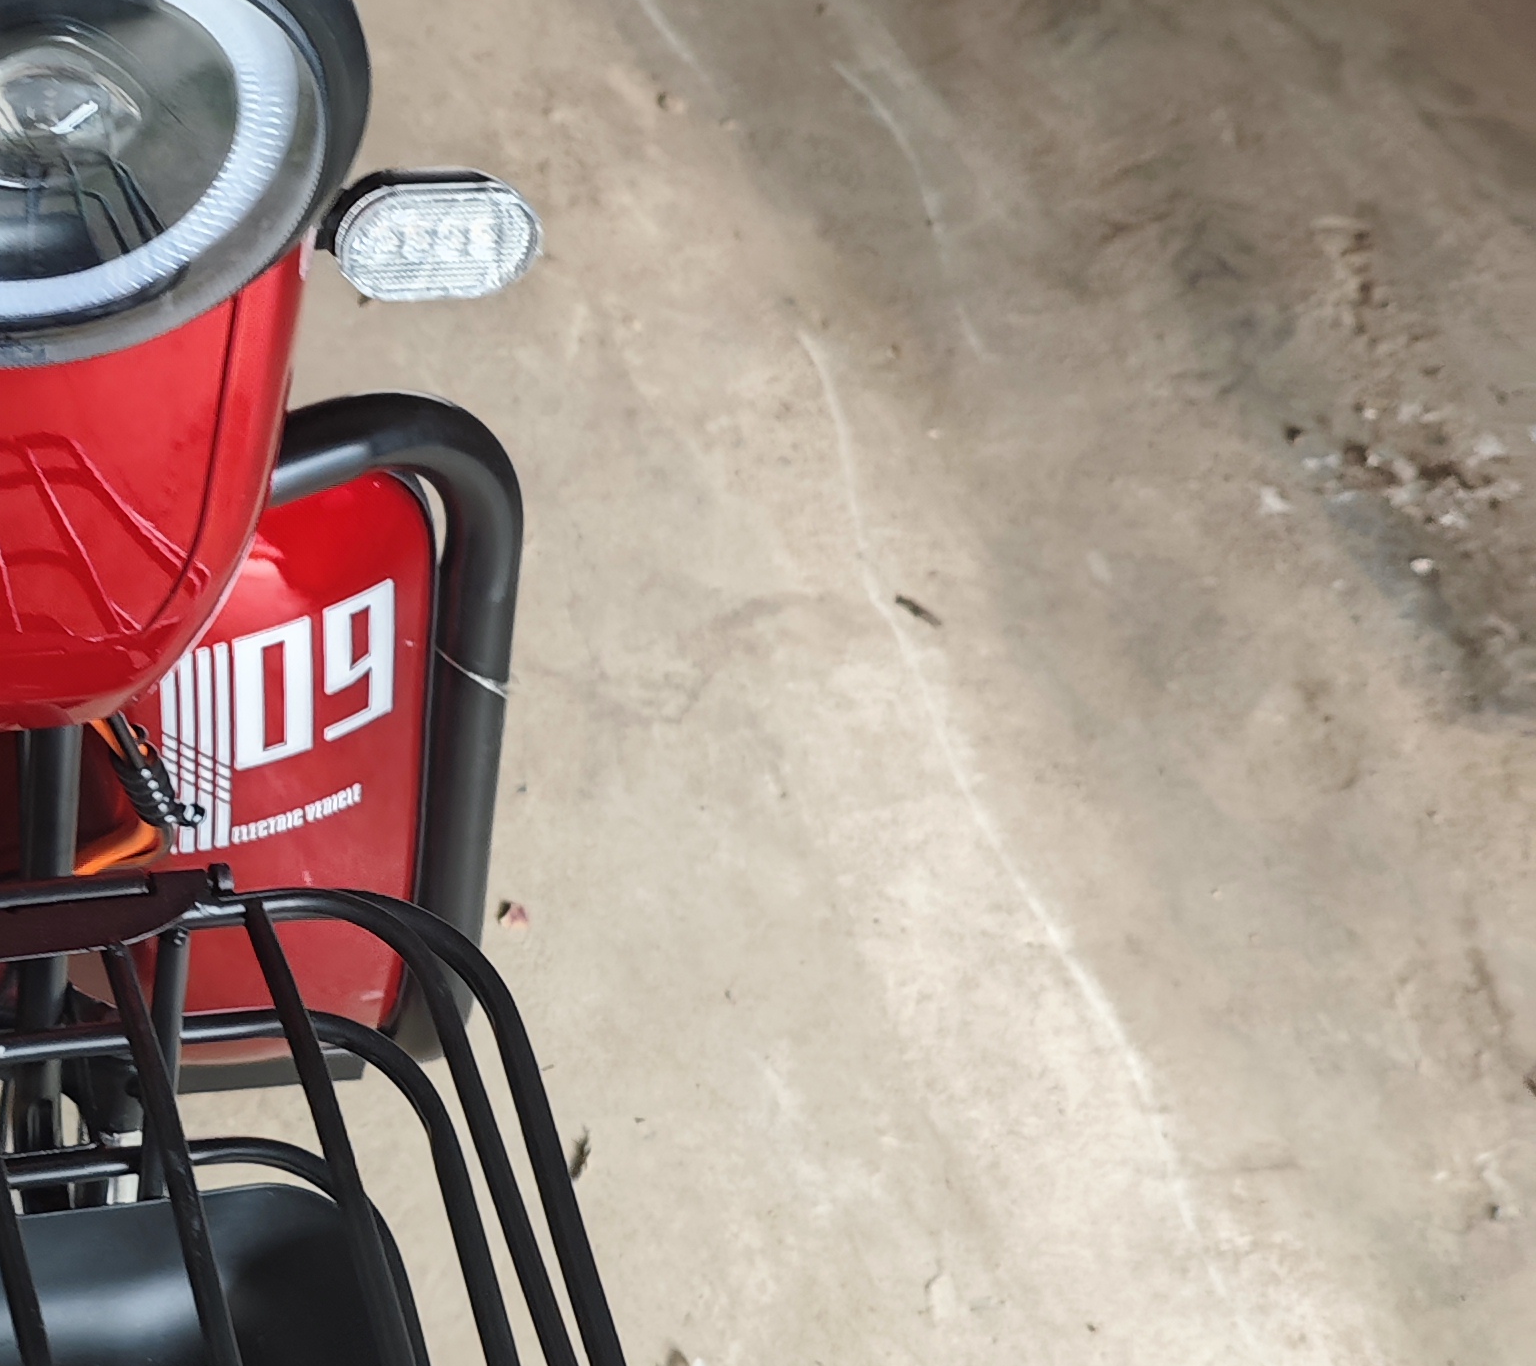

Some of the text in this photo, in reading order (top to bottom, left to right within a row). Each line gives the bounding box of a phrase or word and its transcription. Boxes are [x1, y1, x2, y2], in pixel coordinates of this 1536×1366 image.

[231, 578, 395, 771] 09
[231, 782, 362, 845] ELECTRIC VEHICLE
